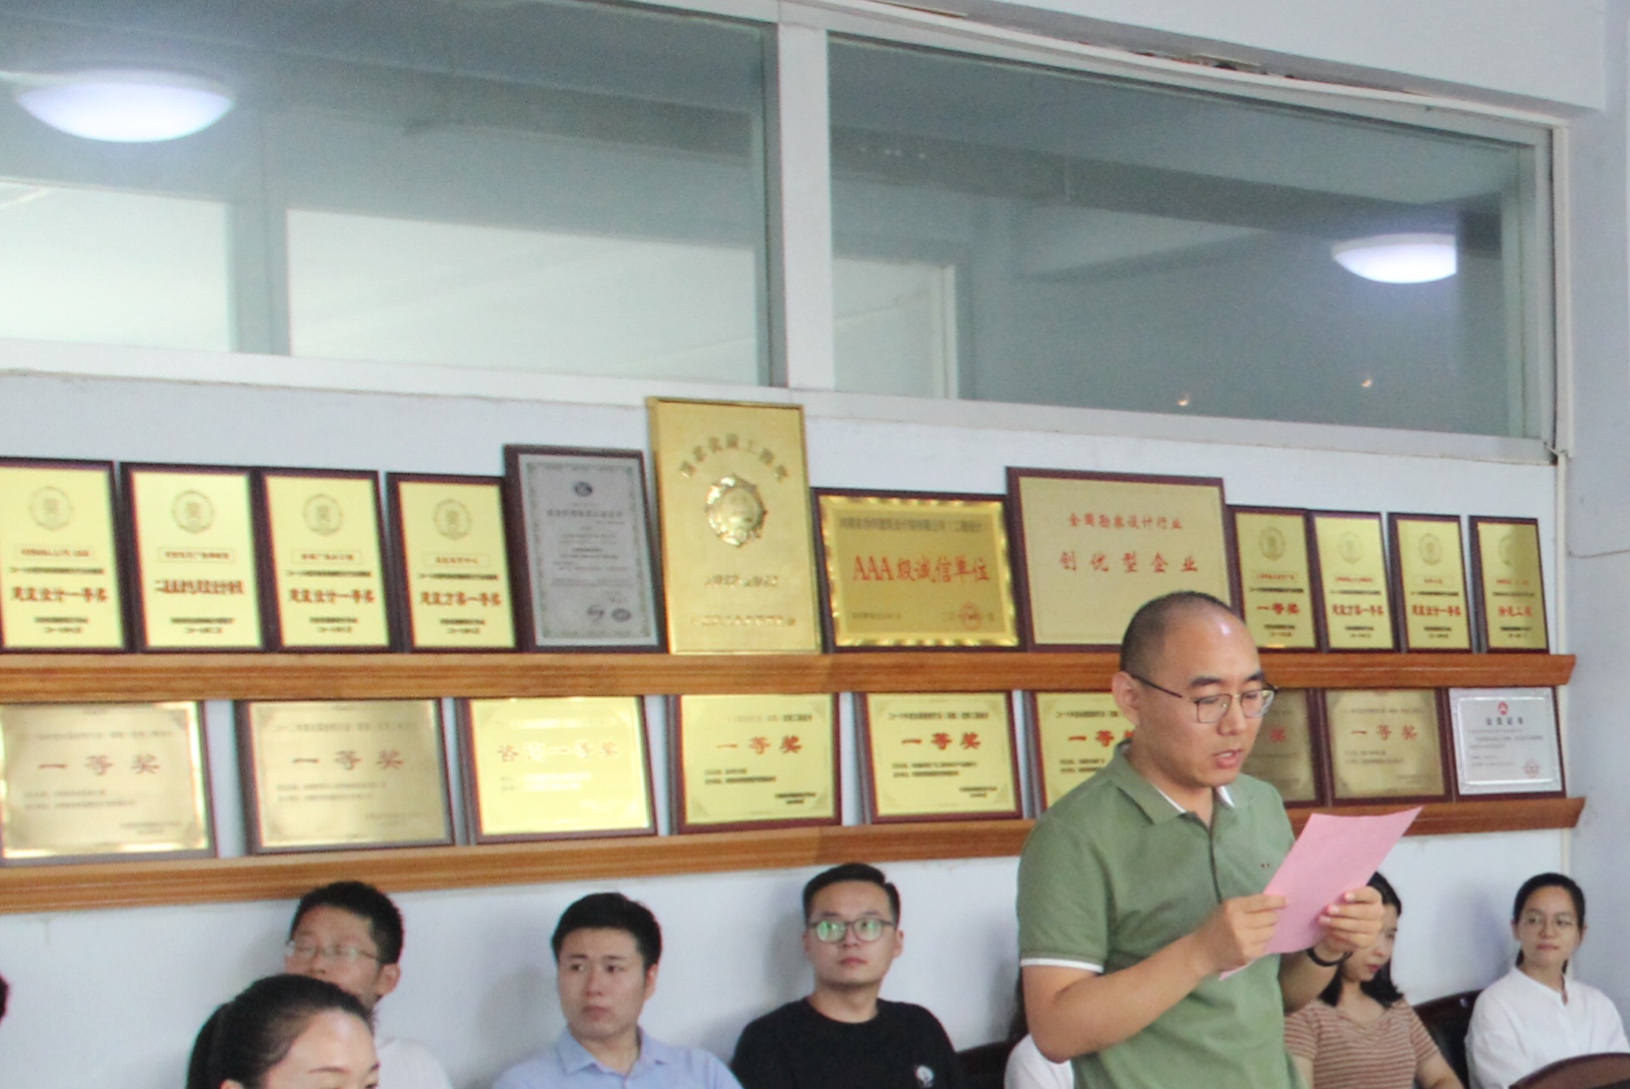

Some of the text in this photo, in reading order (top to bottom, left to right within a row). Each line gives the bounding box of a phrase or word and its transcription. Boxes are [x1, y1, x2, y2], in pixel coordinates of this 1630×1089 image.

[1069, 512, 1183, 530] 全国勘察设计行业
[853, 555, 990, 585] AAA级诚信单位
[1059, 551, 1199, 573] 创优型企业
[901, 731, 981, 750] 一等奖
[1351, 724, 1418, 741] 一等奖
[716, 735, 803, 755] 一等奖
[38, 753, 161, 777] 一等奖
[292, 749, 405, 771] 一等奖
